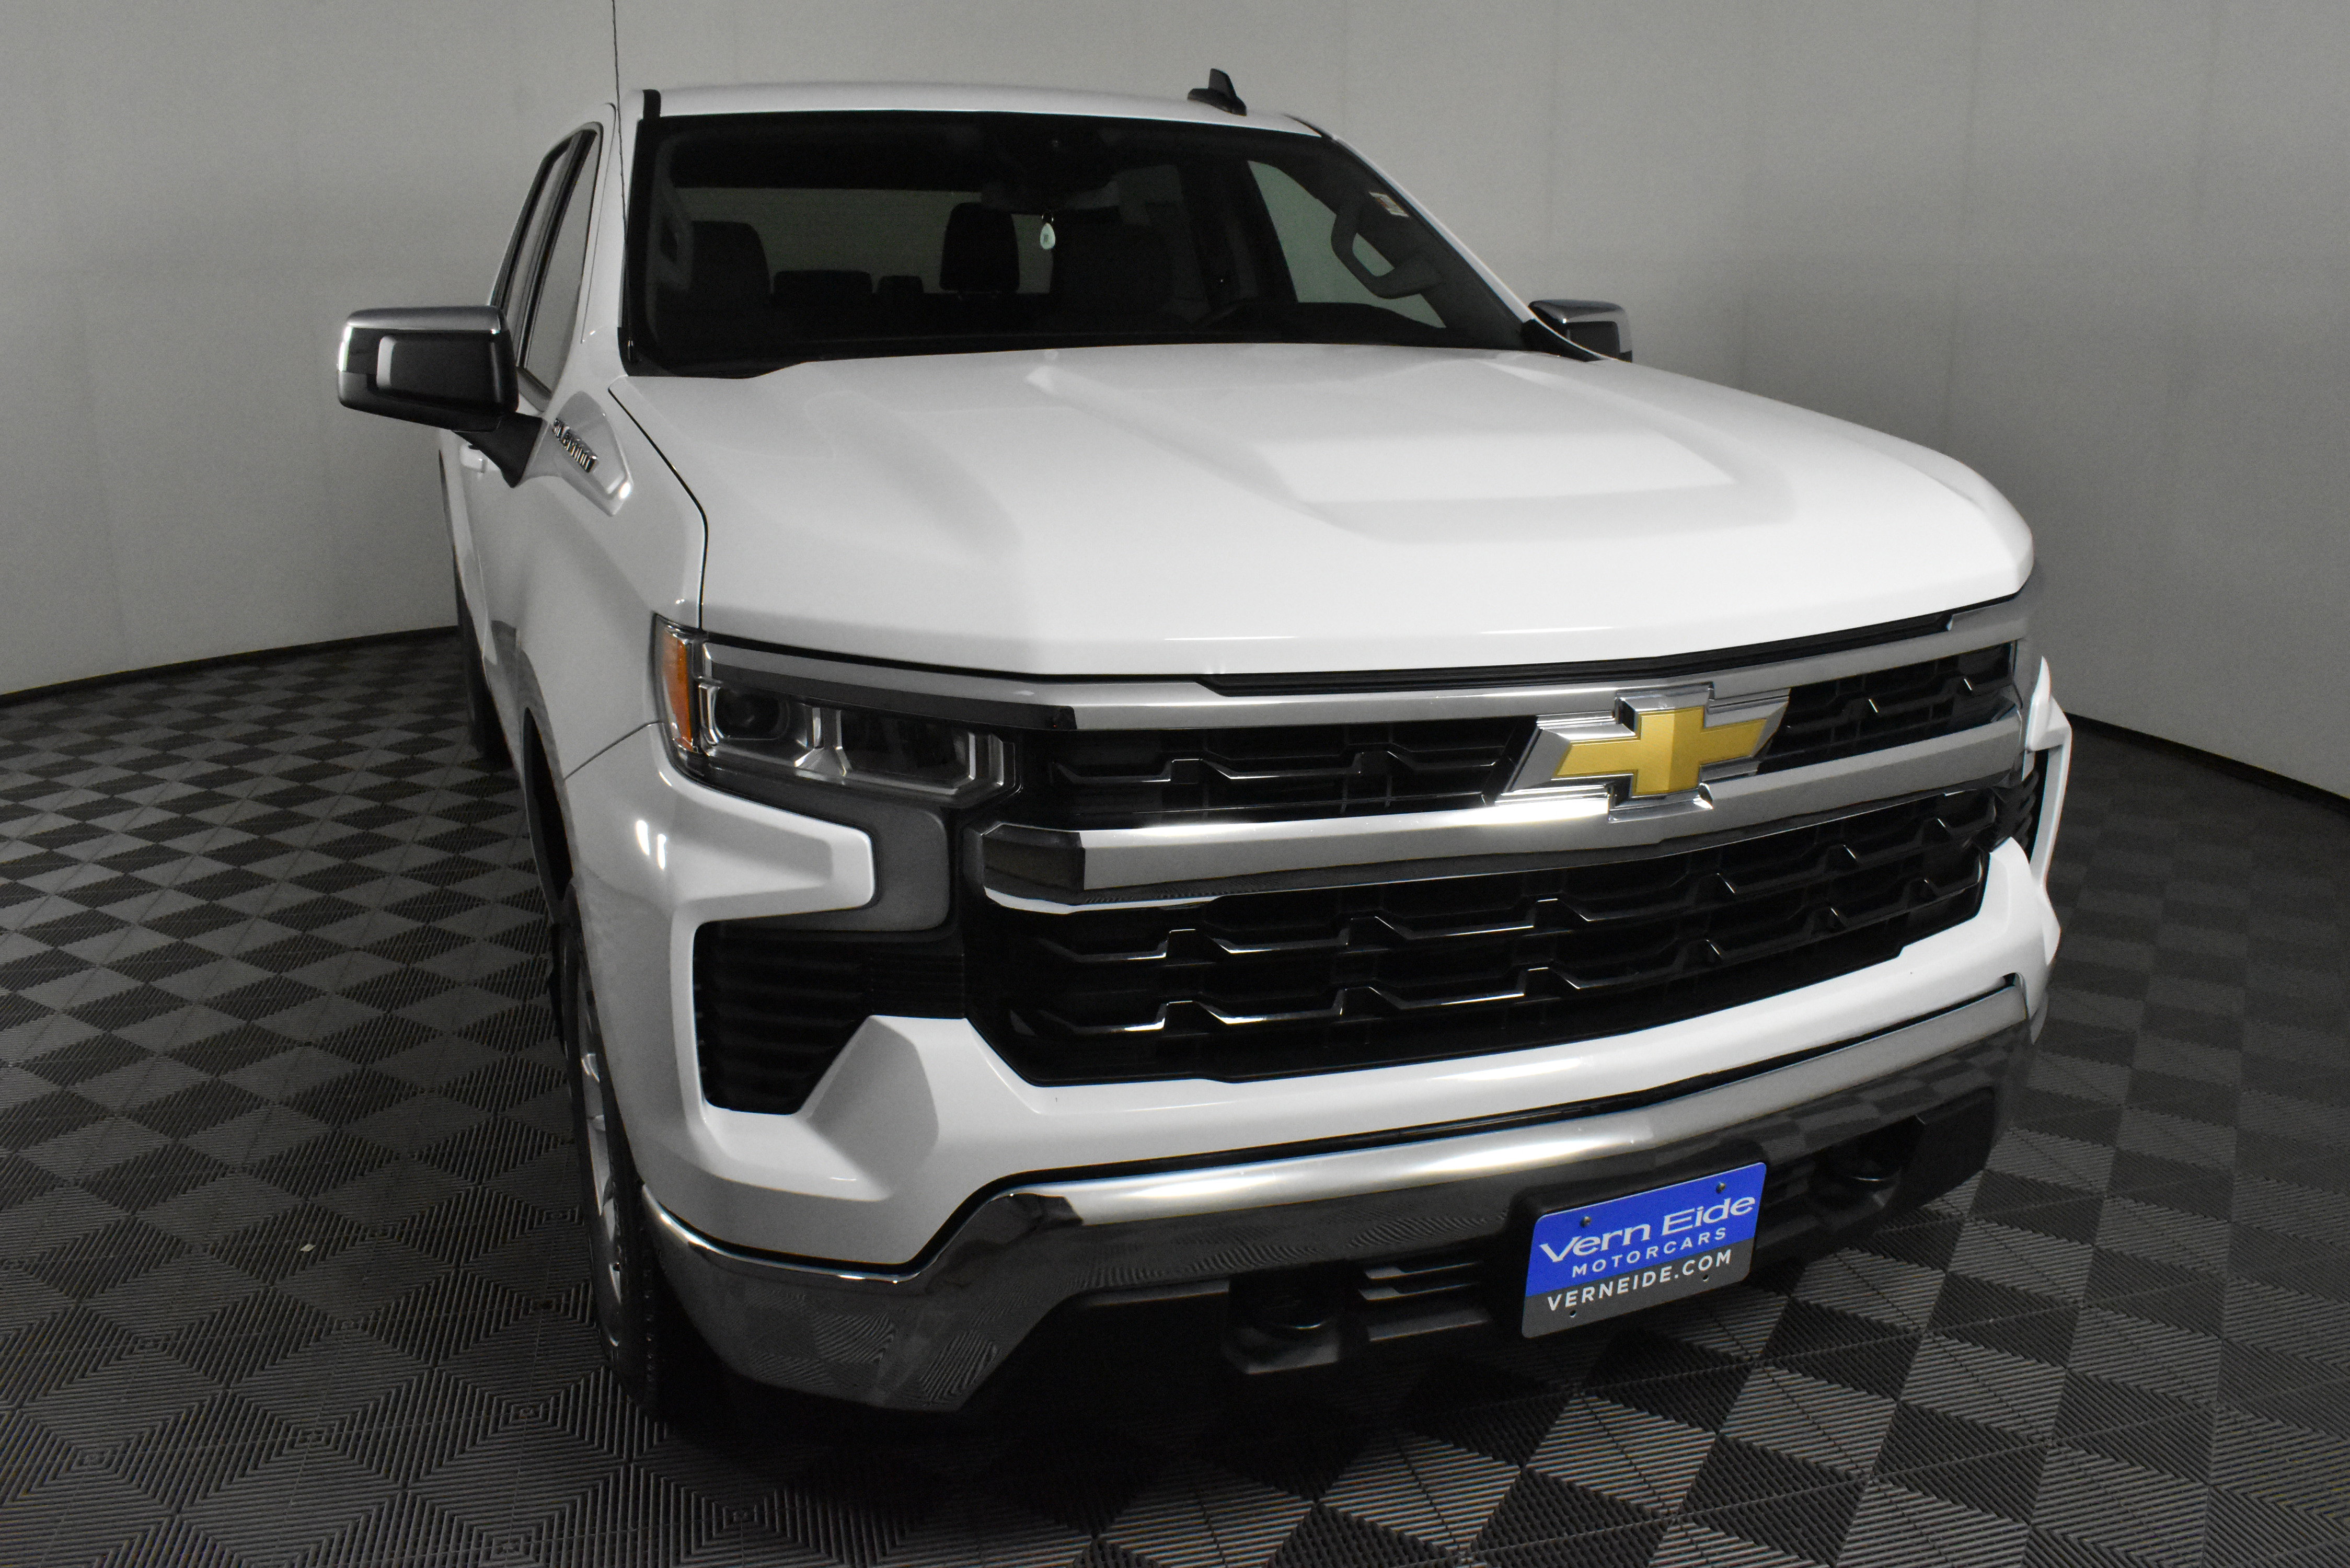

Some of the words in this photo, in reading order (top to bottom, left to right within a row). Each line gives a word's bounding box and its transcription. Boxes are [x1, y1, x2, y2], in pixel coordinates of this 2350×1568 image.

[1540, 1224, 1651, 1263] Vern
[1661, 1197, 1755, 1236] Eide
[1572, 1227, 1726, 1278] MOTORCARS
[1547, 1249, 1731, 1311] VERNEIDE.COM
